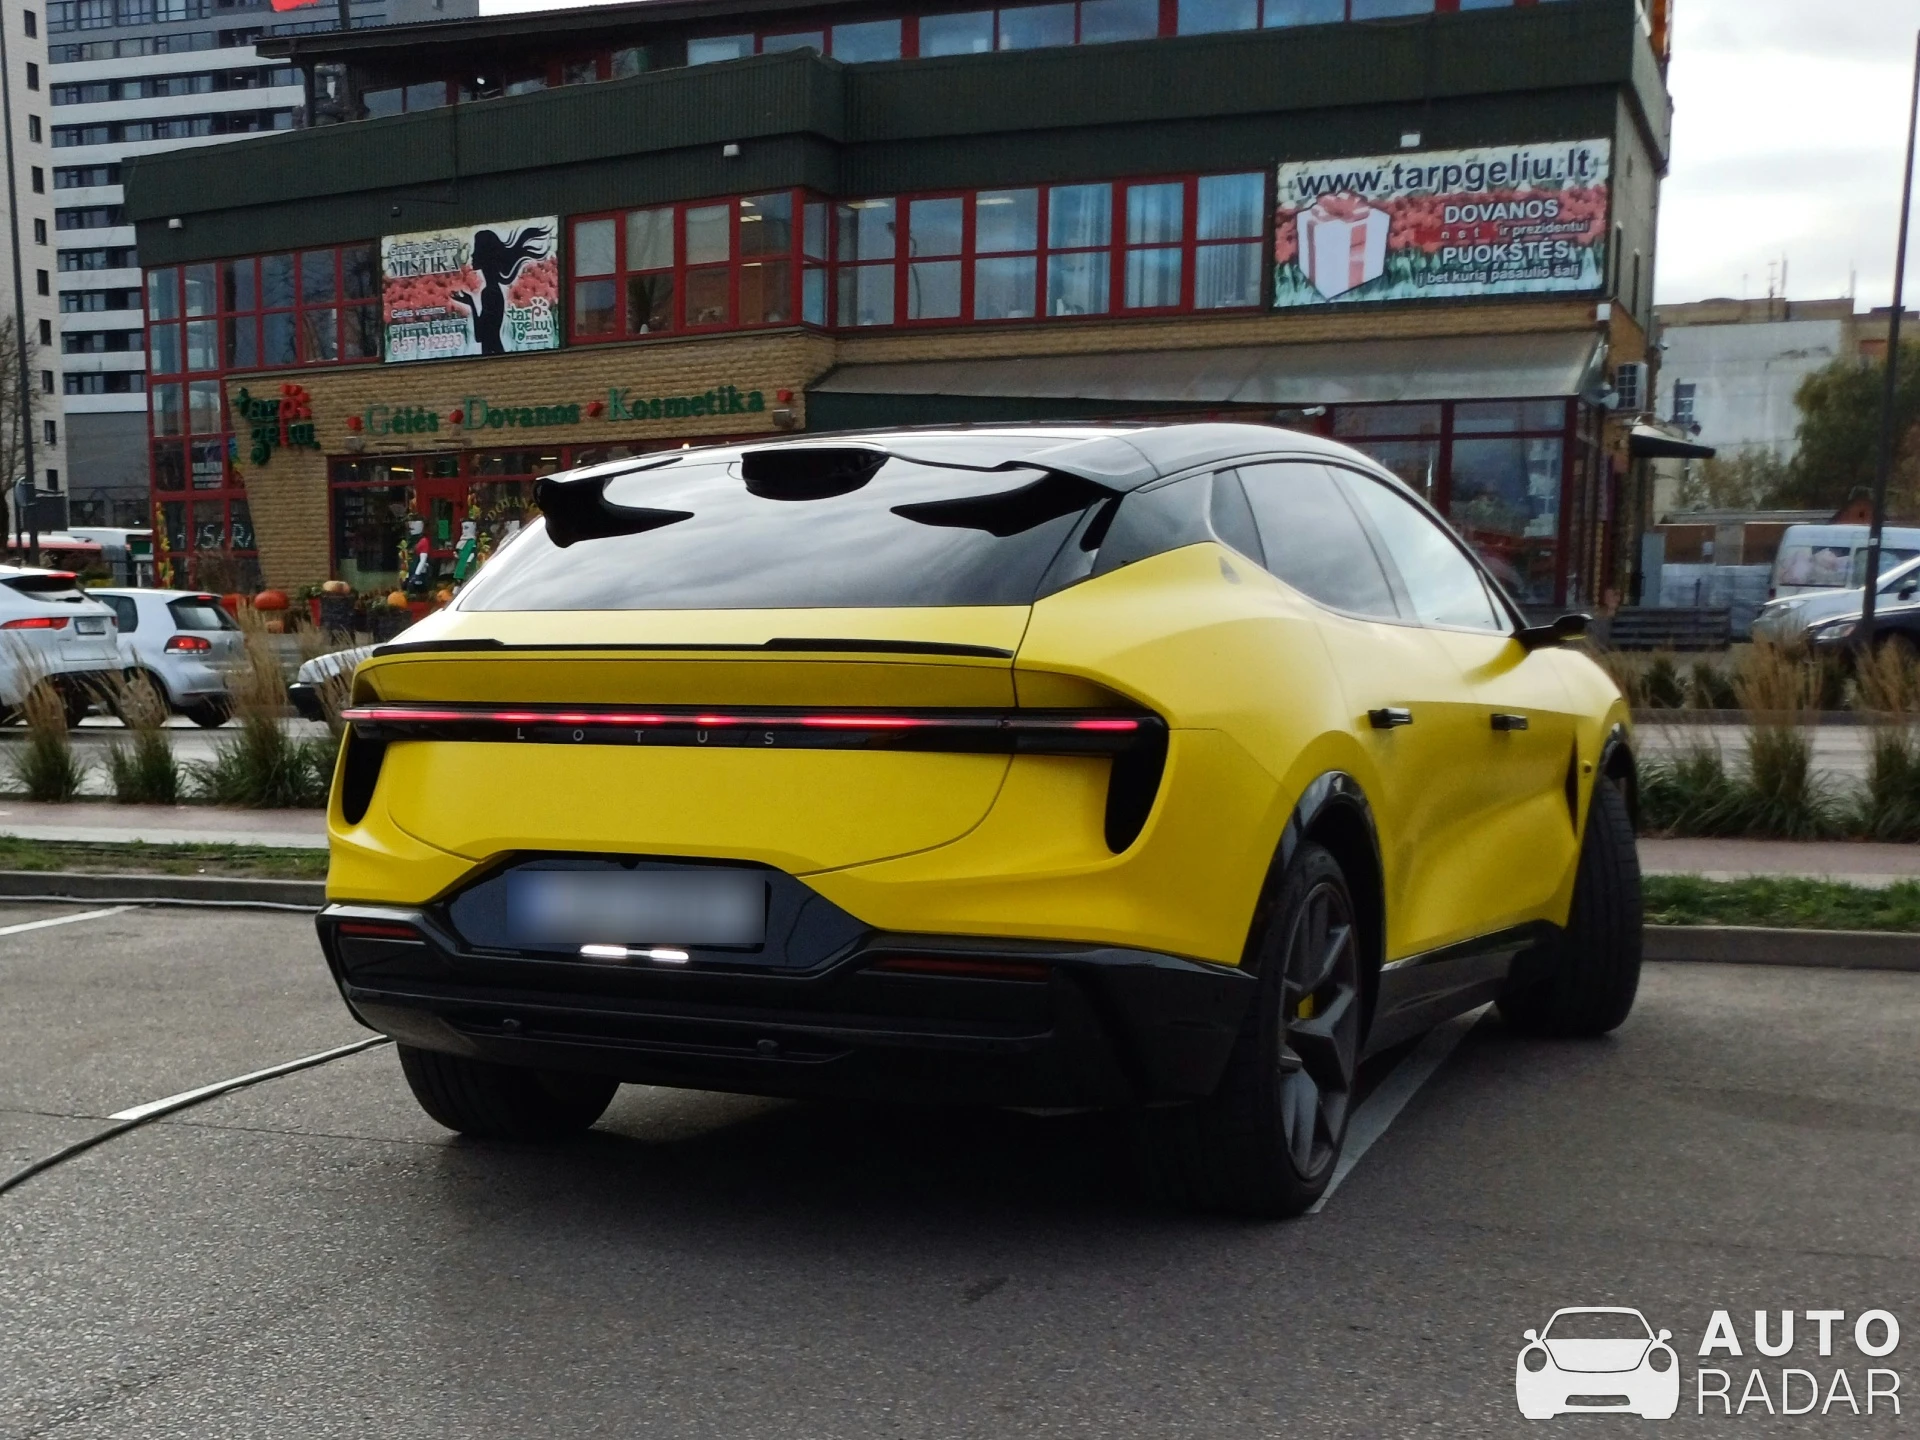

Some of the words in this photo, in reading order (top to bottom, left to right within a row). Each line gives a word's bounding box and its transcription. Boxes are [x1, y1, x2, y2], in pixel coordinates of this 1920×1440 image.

[1297, 149, 1590, 197] www.tarpgeliu.lt
[1444, 200, 1558, 223] DOVANOS
[1512, 221, 1588, 238] prezidentui
[1442, 239, 1570, 265] PUOKŠTĖS
[388, 255, 459, 277] MISTIKA
[1427, 272, 1448, 284] bet
[1452, 270, 1487, 283] kurią
[1491, 266, 1550, 283] pasaulio
[463, 396, 580, 430] Dovanos
[608, 385, 765, 421] Kosmetika
[516, 727, 775, 745] LOTUS
